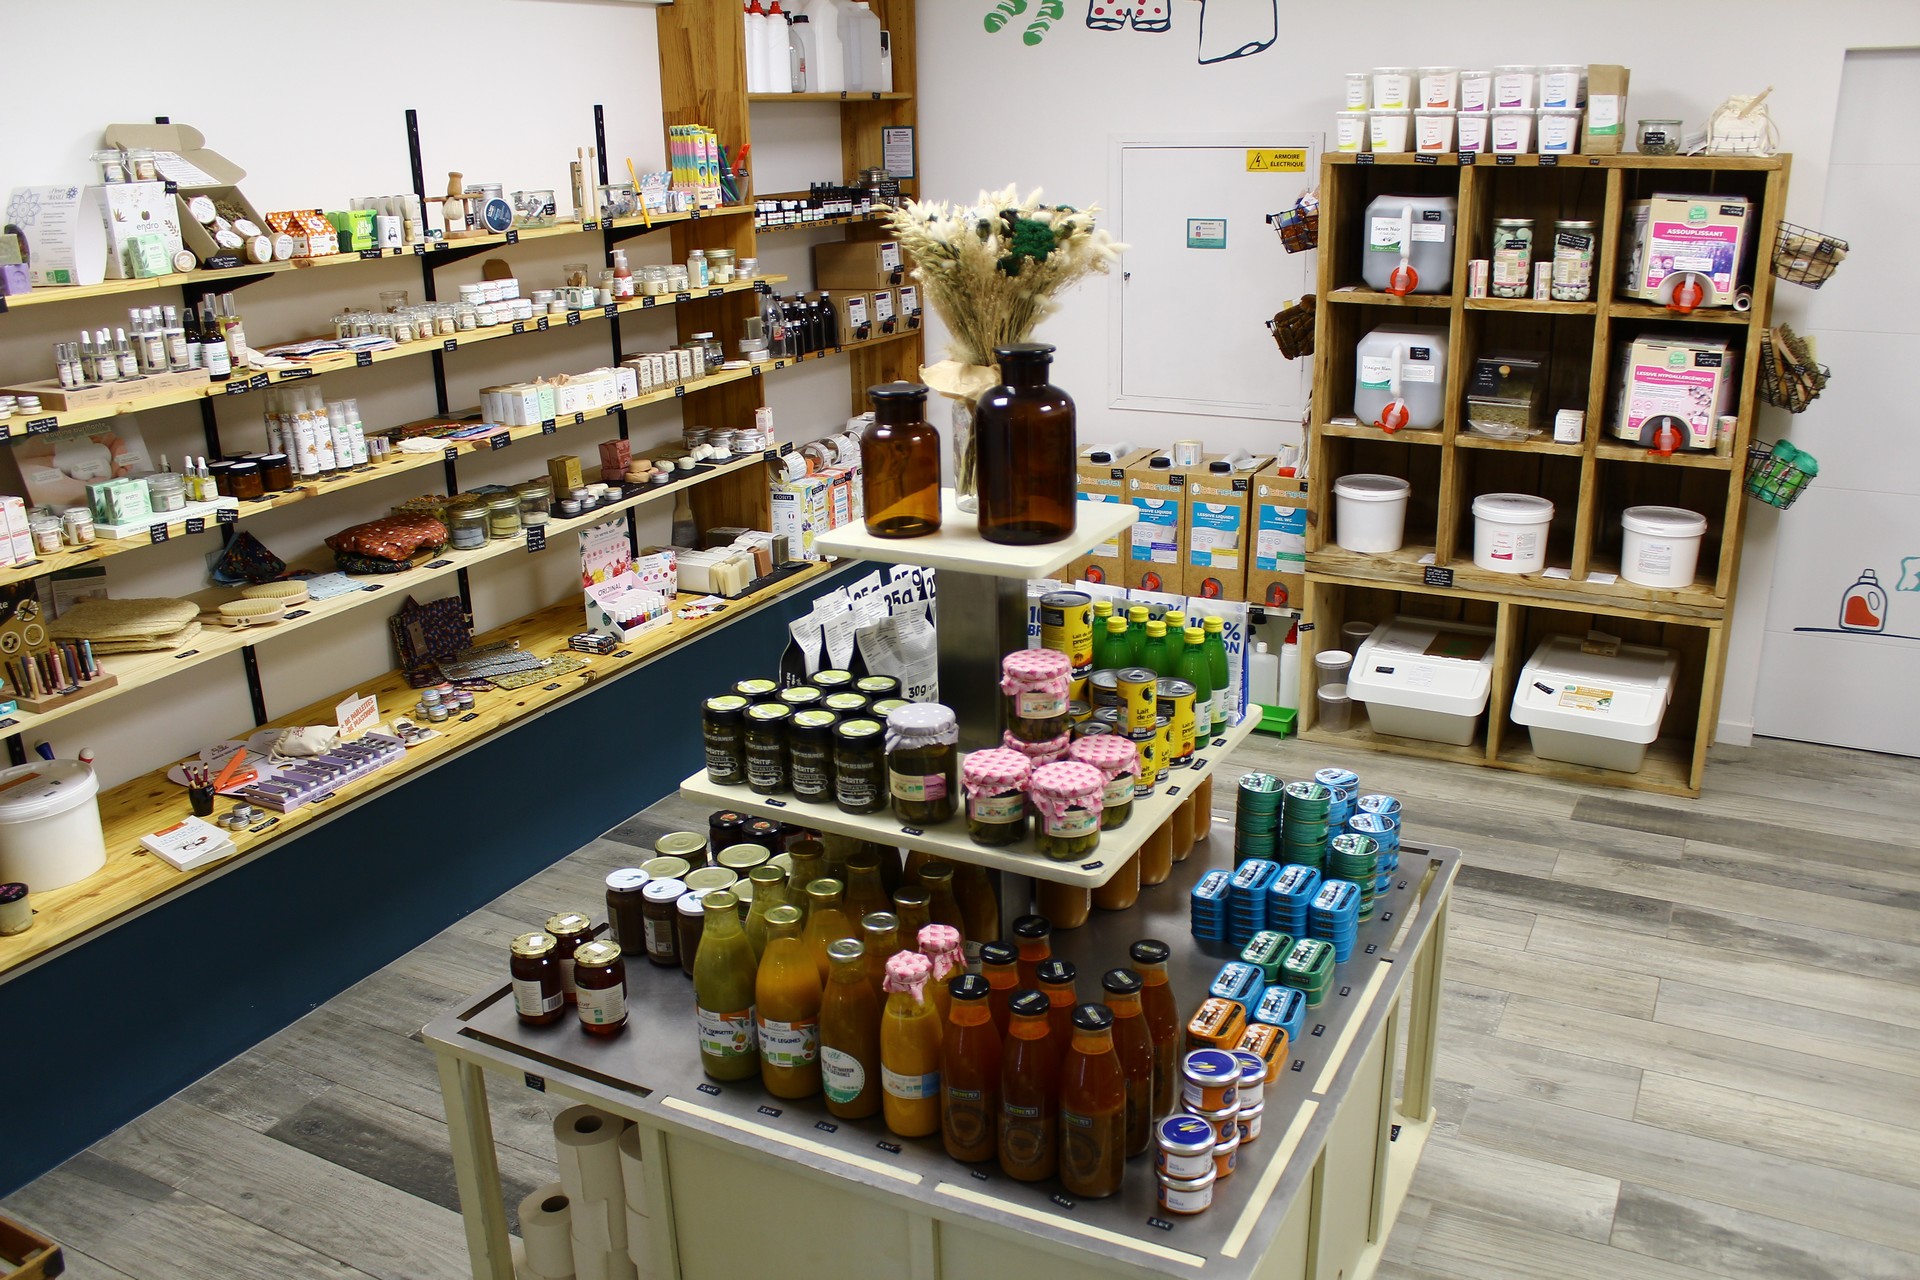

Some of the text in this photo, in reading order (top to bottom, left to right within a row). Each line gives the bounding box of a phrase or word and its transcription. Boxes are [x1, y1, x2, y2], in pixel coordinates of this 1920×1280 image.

[1270, 160, 1305, 168] ÉLECTRIQUE
[136, 221, 160, 232] endro
[1667, 228, 1724, 237] ASSOUPLISSANT
[908, 684, 927, 699] 30g
